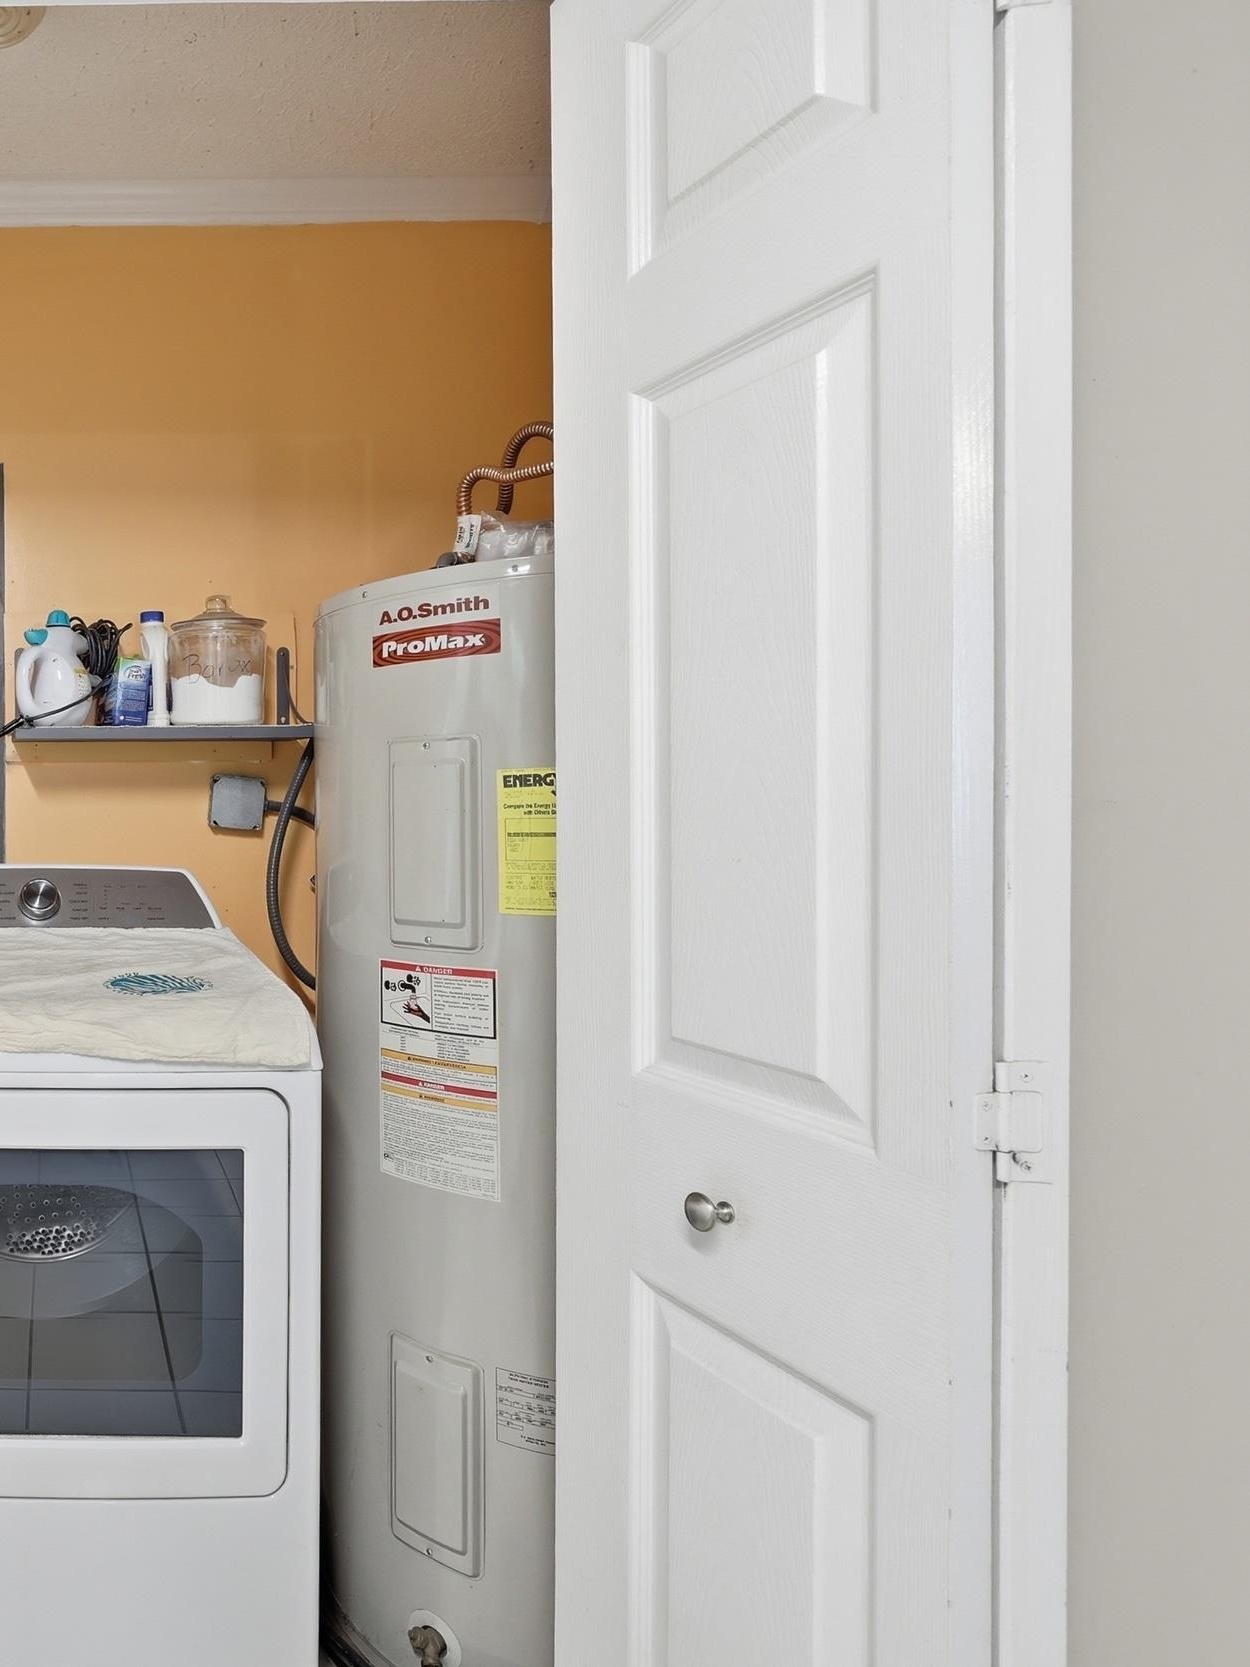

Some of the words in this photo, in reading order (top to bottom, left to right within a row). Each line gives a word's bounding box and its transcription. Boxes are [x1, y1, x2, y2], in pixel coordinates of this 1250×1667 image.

[382, 633, 486, 658] ProMax
[502, 772, 556, 788] ENERG
[423, 966, 453, 975] DANGER
